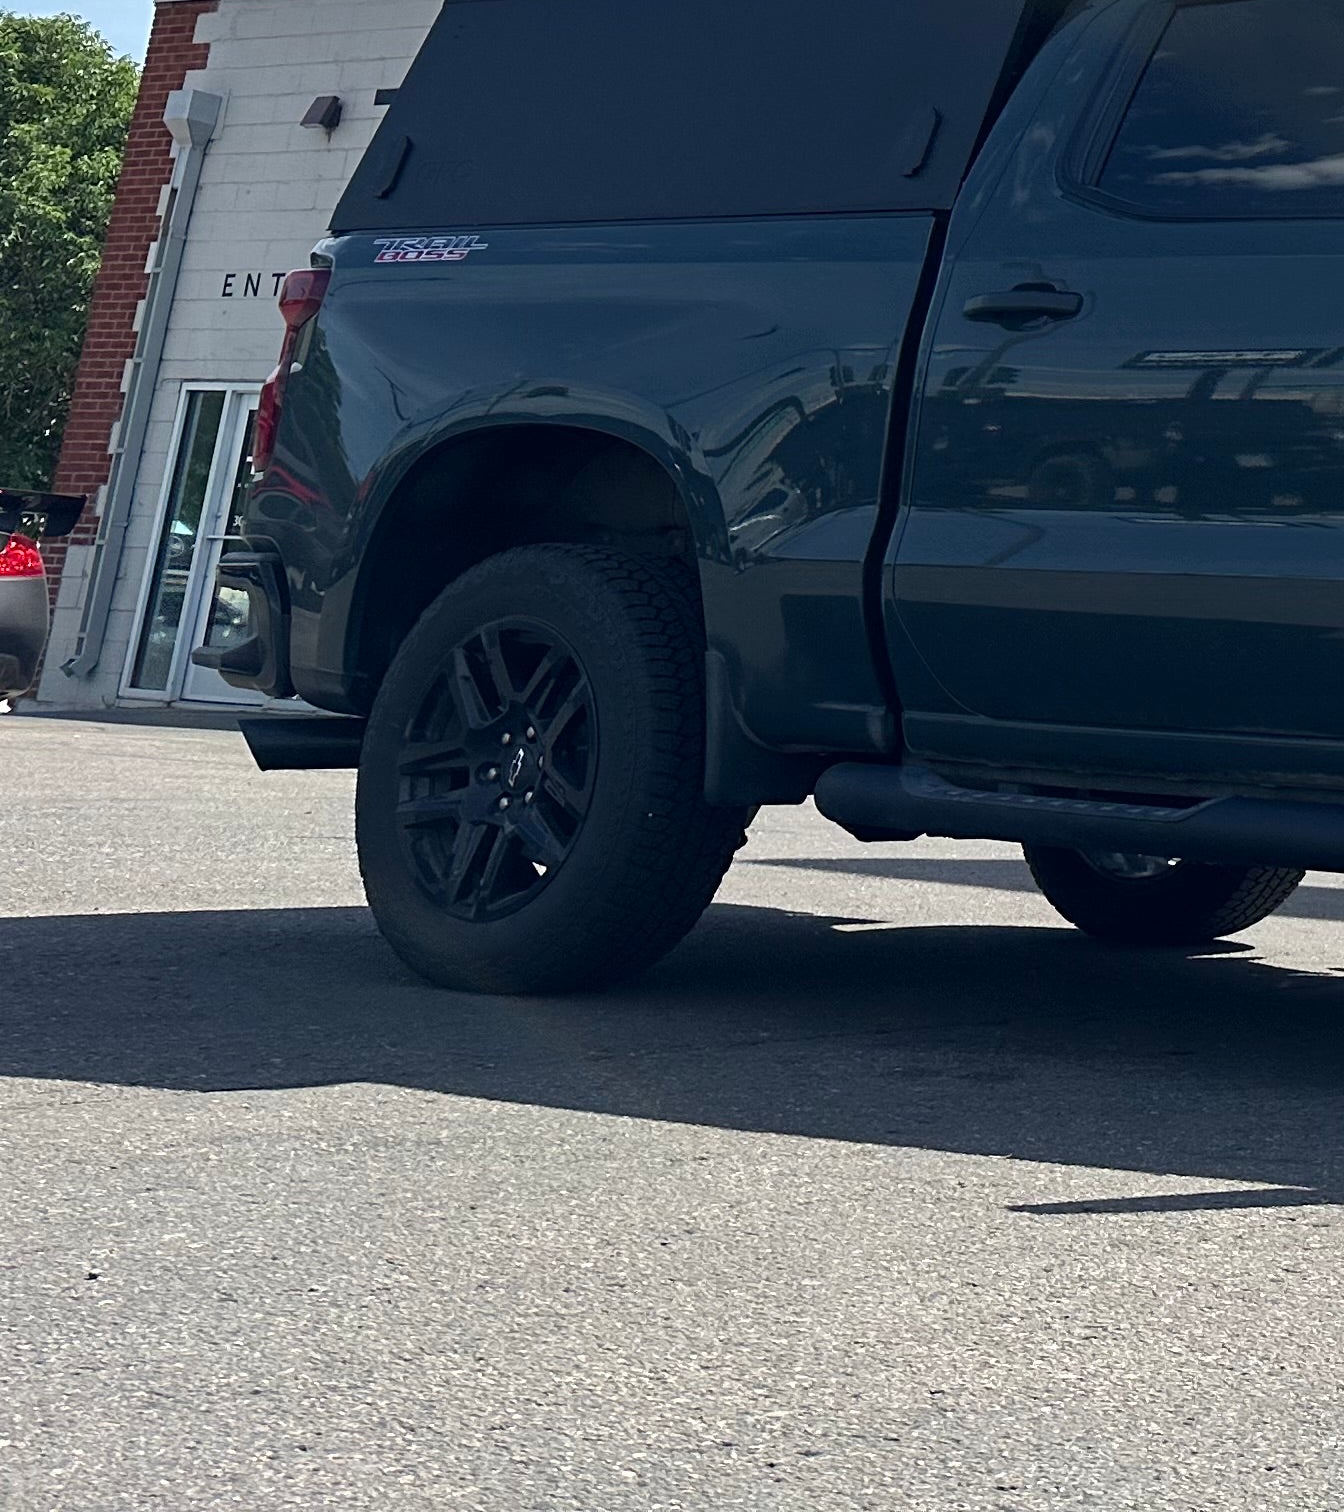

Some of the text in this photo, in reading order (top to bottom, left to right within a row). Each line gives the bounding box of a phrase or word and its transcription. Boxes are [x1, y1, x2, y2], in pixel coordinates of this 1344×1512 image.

[373, 235, 488, 251] TRAIL
[374, 249, 471, 263] BOSS
[221, 273, 286, 297] ENT
